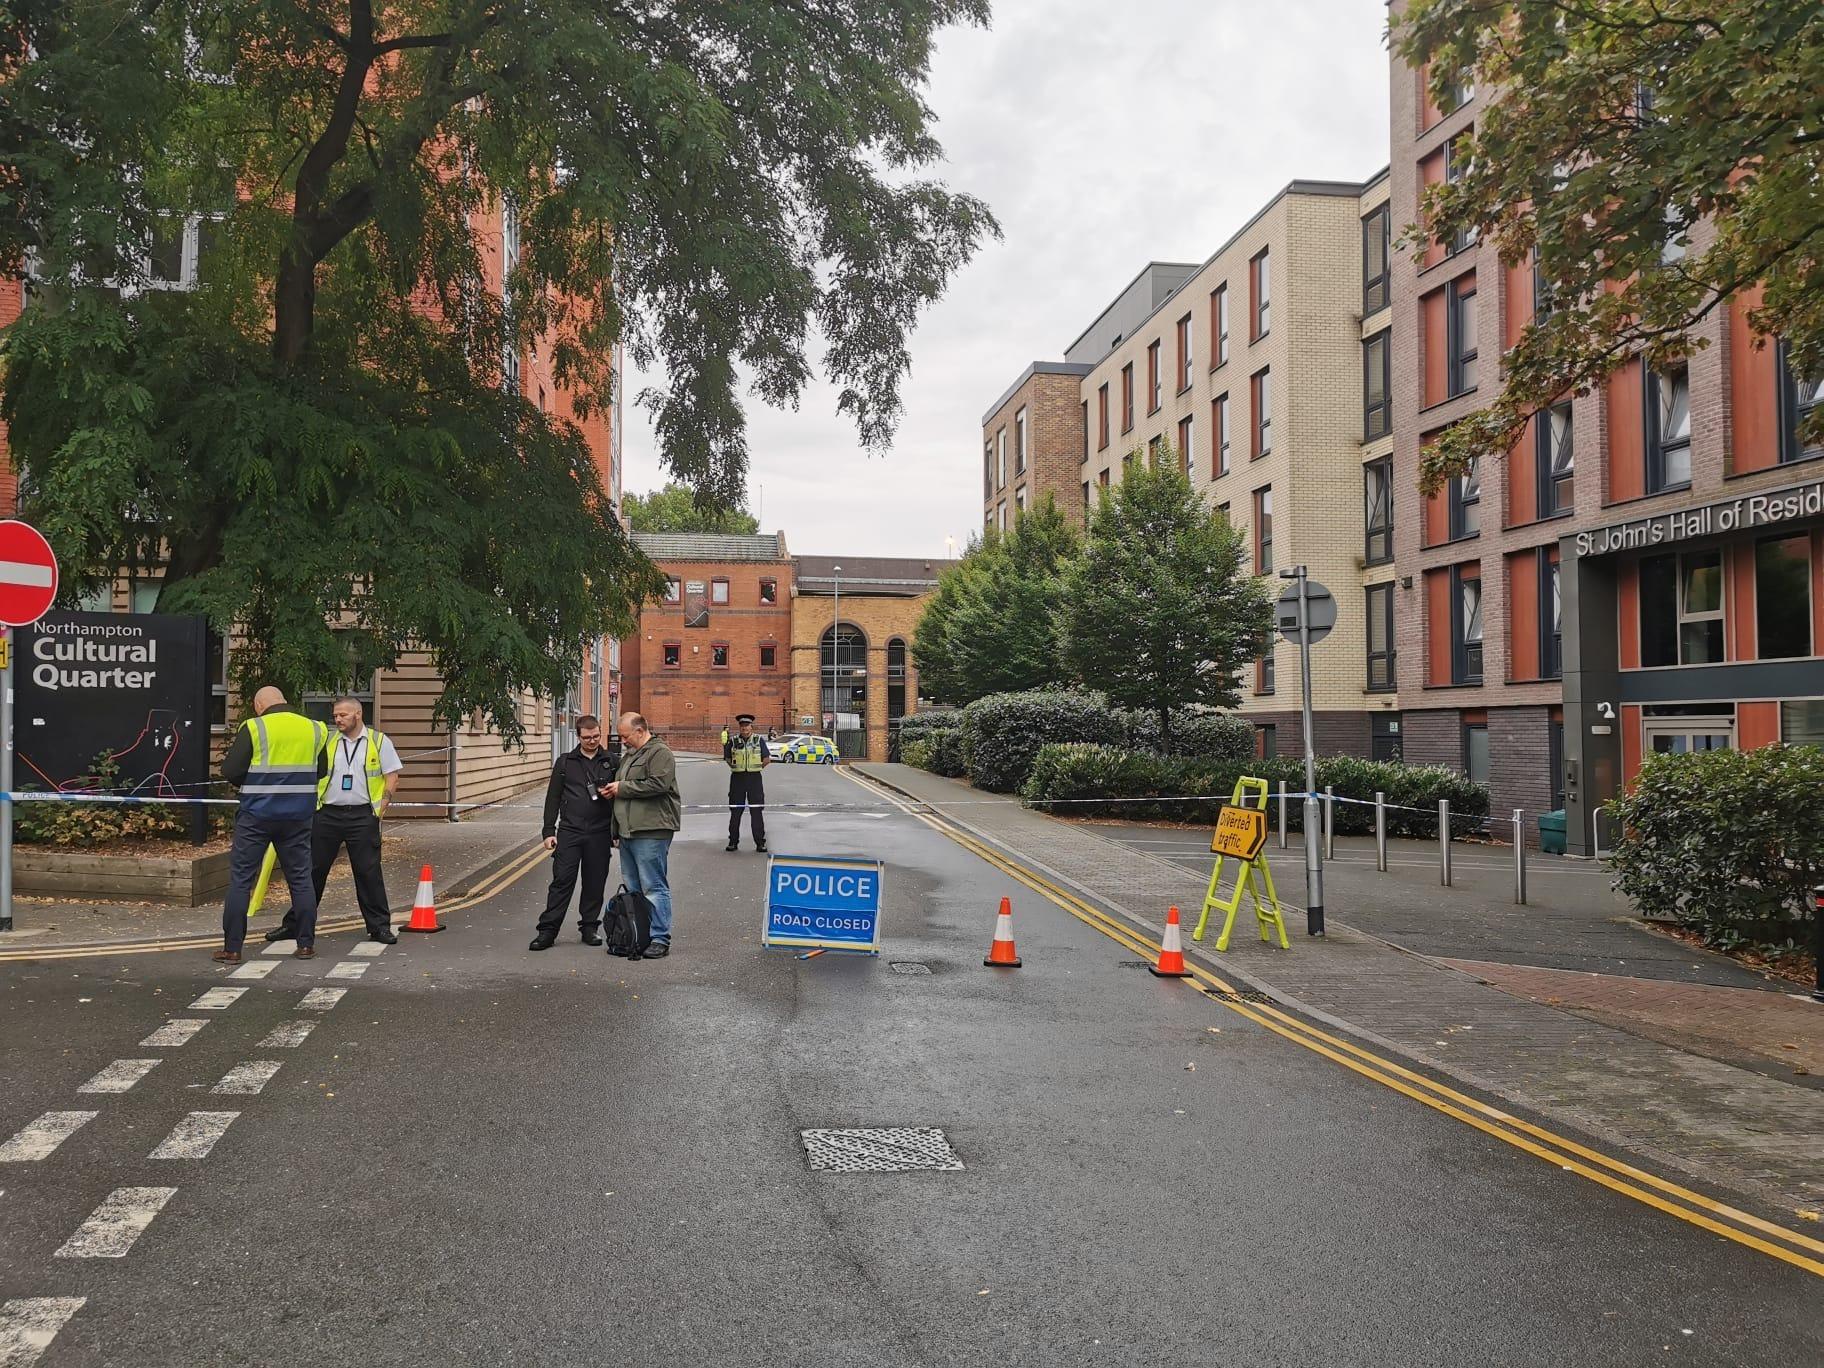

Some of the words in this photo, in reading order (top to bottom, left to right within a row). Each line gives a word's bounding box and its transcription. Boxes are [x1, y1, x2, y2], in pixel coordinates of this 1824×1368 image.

[1576, 532, 1595, 556] St
[1599, 519, 1664, 552] John's
[1669, 507, 1712, 539] Hall
[1719, 500, 1743, 530] of
[1750, 484, 1824, 525] Resid
[34, 621, 142, 638] Northampton
[33, 637, 156, 662] Cultural
[33, 663, 156, 690] Quarter
[1220, 812, 1251, 831] Diverted
[1218, 832, 1241, 849] traffic
[777, 872, 871, 898] POLICE
[773, 914, 811, 927] ROAD
[815, 917, 871, 930] CLOSED
